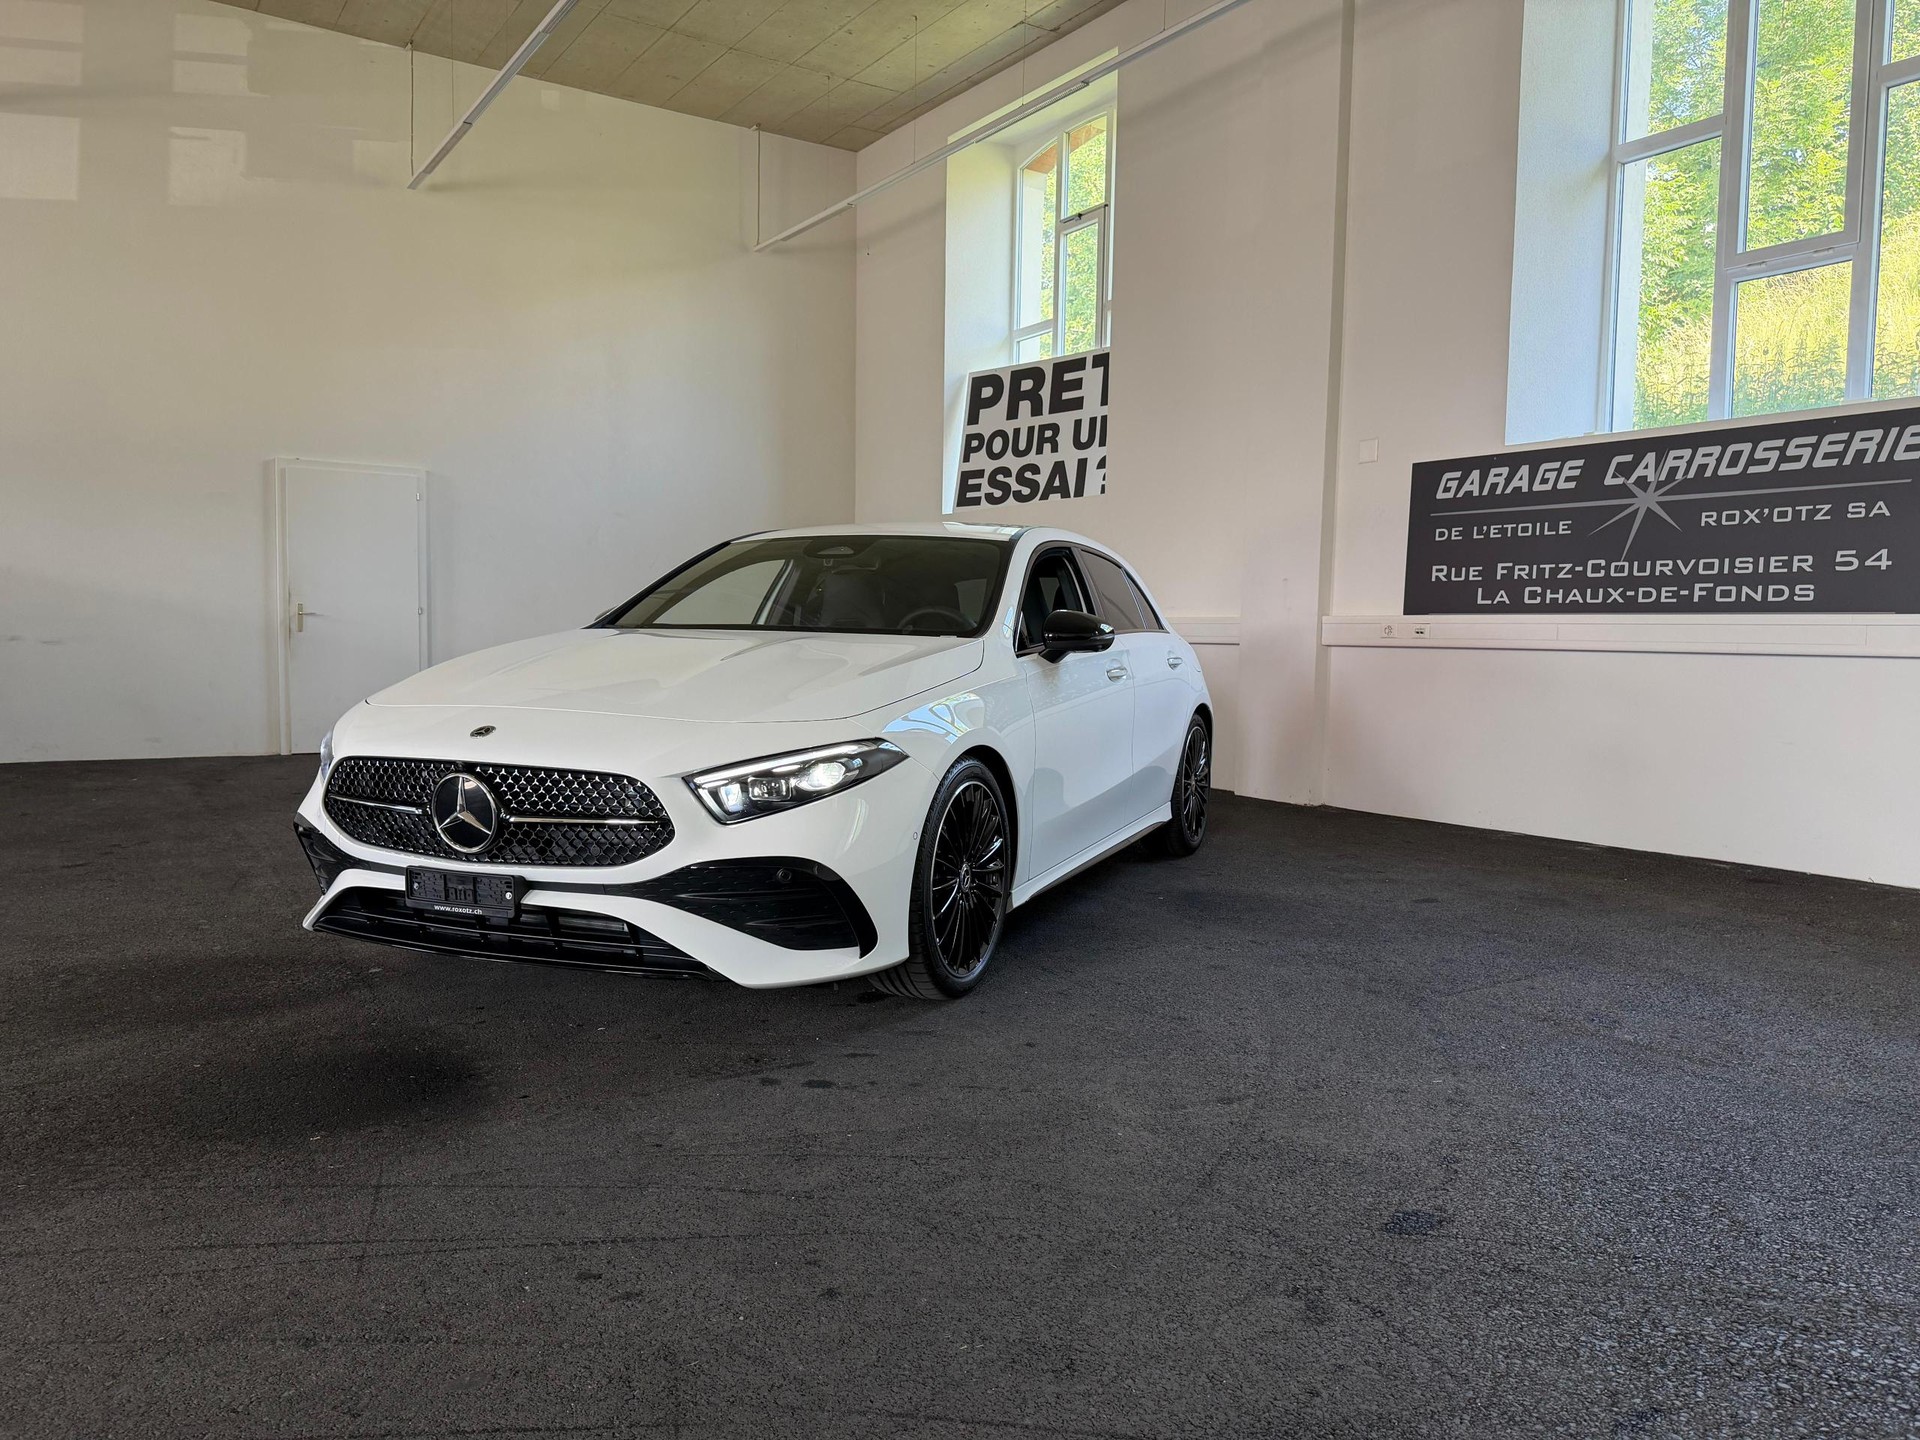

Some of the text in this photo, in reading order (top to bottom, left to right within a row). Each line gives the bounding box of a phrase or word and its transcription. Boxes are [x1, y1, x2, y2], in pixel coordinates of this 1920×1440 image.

[962, 422, 1060, 463] POUR
[1436, 424, 1920, 499] GARAGE CARROSSERIE
[956, 456, 1088, 508] ESSAI
[1701, 501, 1891, 527] ROX'OTZ SA
[1435, 520, 1572, 541] DE L'ETOILE
[1431, 548, 1892, 582] RUE FRITZ-COURVOISIER 54
[1477, 583, 1815, 605] LA CHAUX-DE-FONDS
[433, 904, 483, 916] www.roxotz.ch
